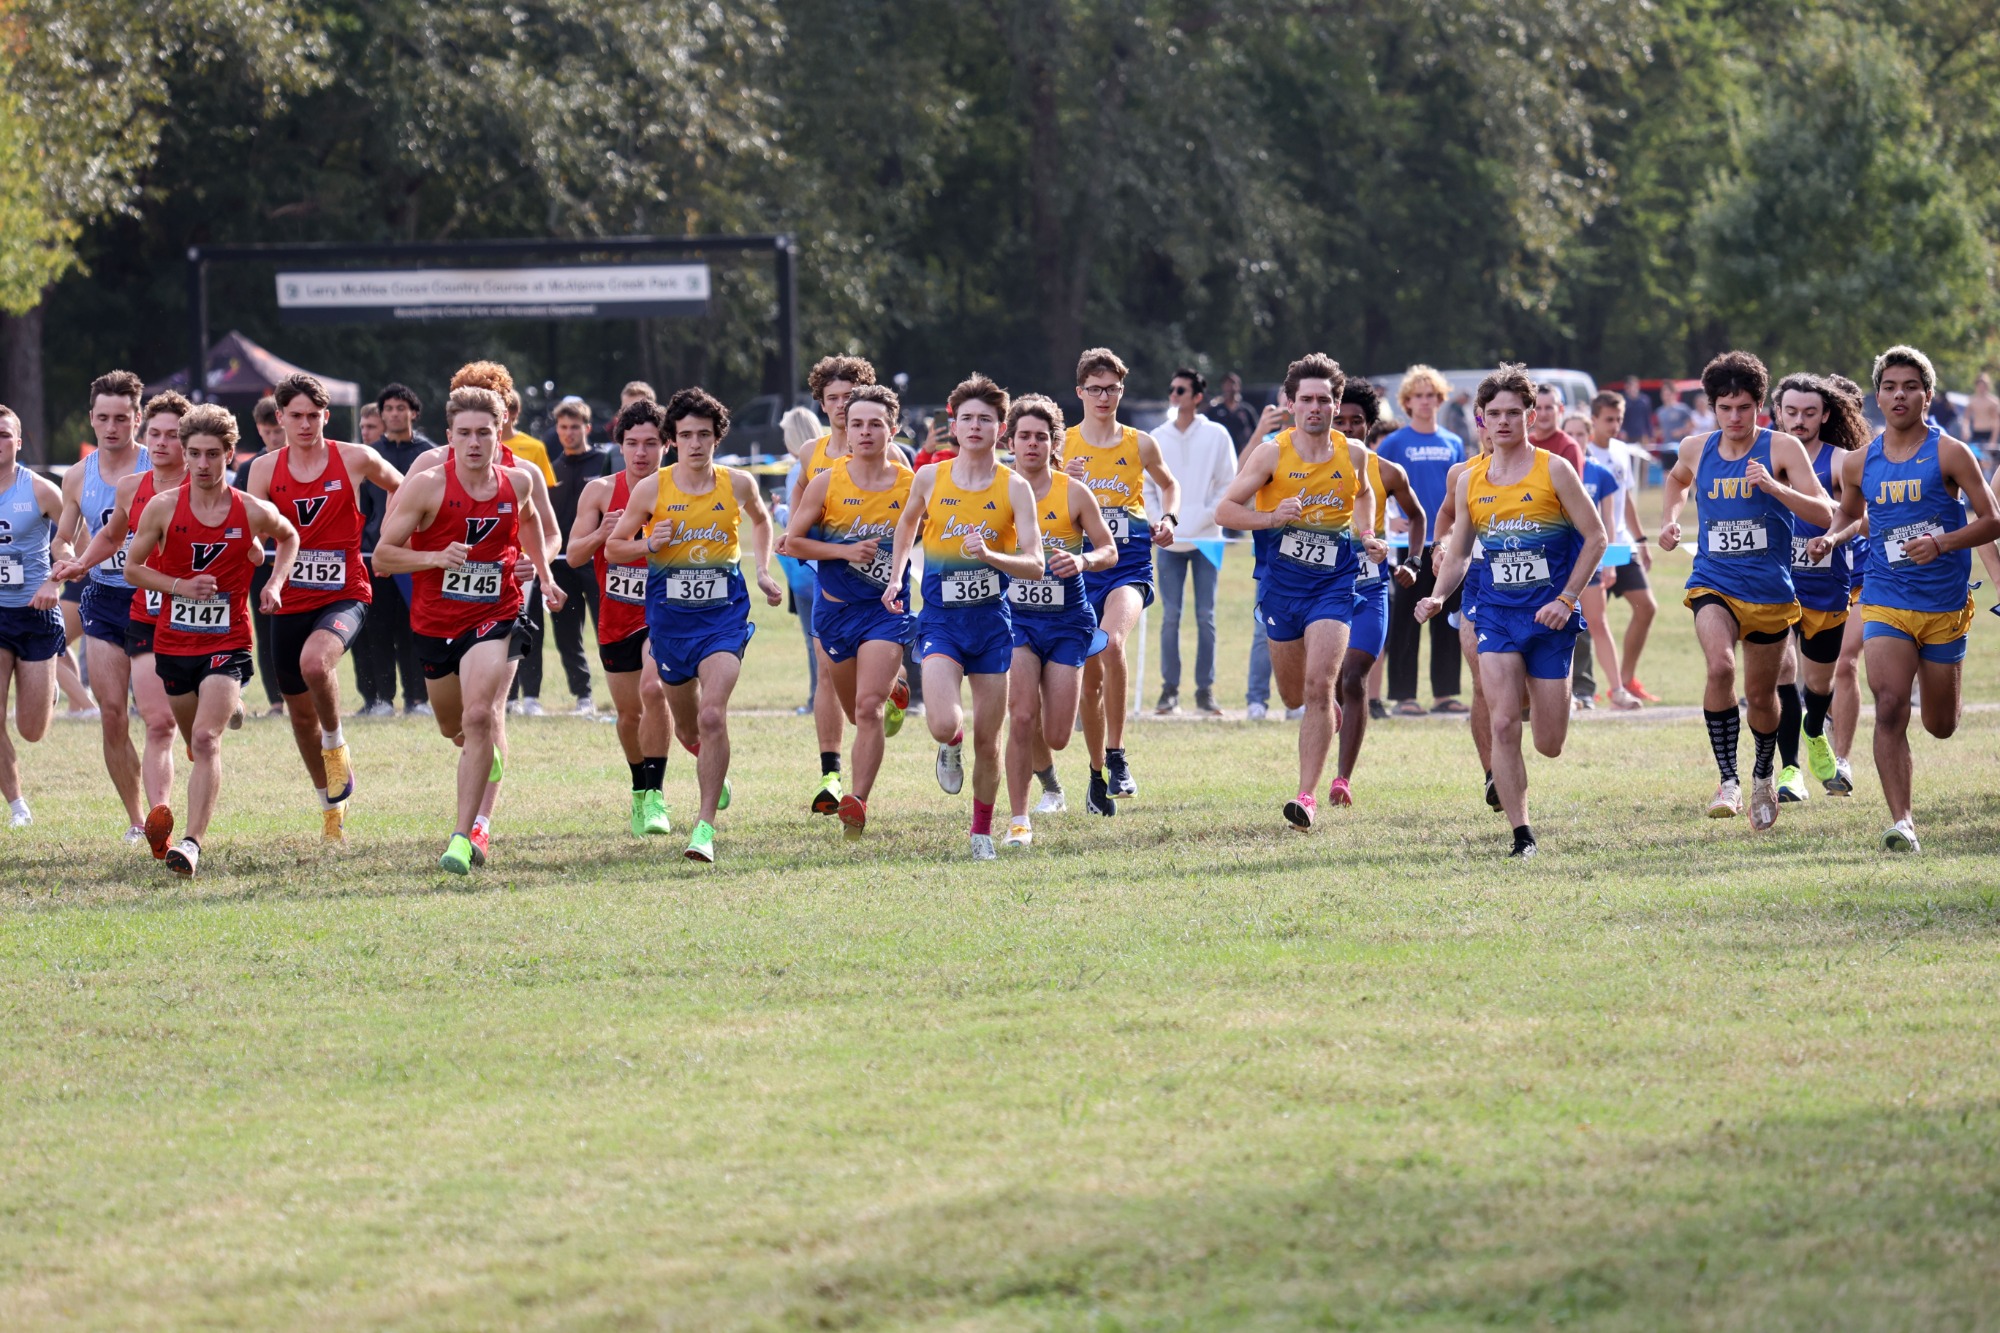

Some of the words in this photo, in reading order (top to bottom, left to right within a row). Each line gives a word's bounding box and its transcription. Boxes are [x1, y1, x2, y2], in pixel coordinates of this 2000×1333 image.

[305, 284, 336, 298] Larry
[391, 282, 427, 296] Cross
[431, 280, 479, 295] Country
[483, 280, 527, 294] Course
[532, 280, 544, 292] at
[608, 278, 645, 291] Creek
[650, 277, 677, 289] Park
[1708, 477, 1753, 499] JWU
[1876, 479, 1921, 504] JWU
[292, 495, 328, 527] V
[667, 504, 689, 512] PBC
[940, 498, 961, 506] PBC
[465, 517, 500, 547] V
[669, 520, 729, 547] Lander
[843, 514, 894, 540] Lande
[1487, 513, 1541, 539] Lander
[1718, 530, 1755, 551] 354
[191, 542, 228, 571] V
[1292, 541, 1326, 563] 373
[293, 562, 341, 581] 2152
[1501, 562, 1536, 583] 372
[446, 573, 497, 594] 2145
[609, 576, 644, 597] 214
[680, 580, 716, 599] 367
[955, 579, 990, 600] 365
[1017, 585, 1053, 604] 368
[175, 603, 225, 624] 2147
[210, 655, 232, 669] V
